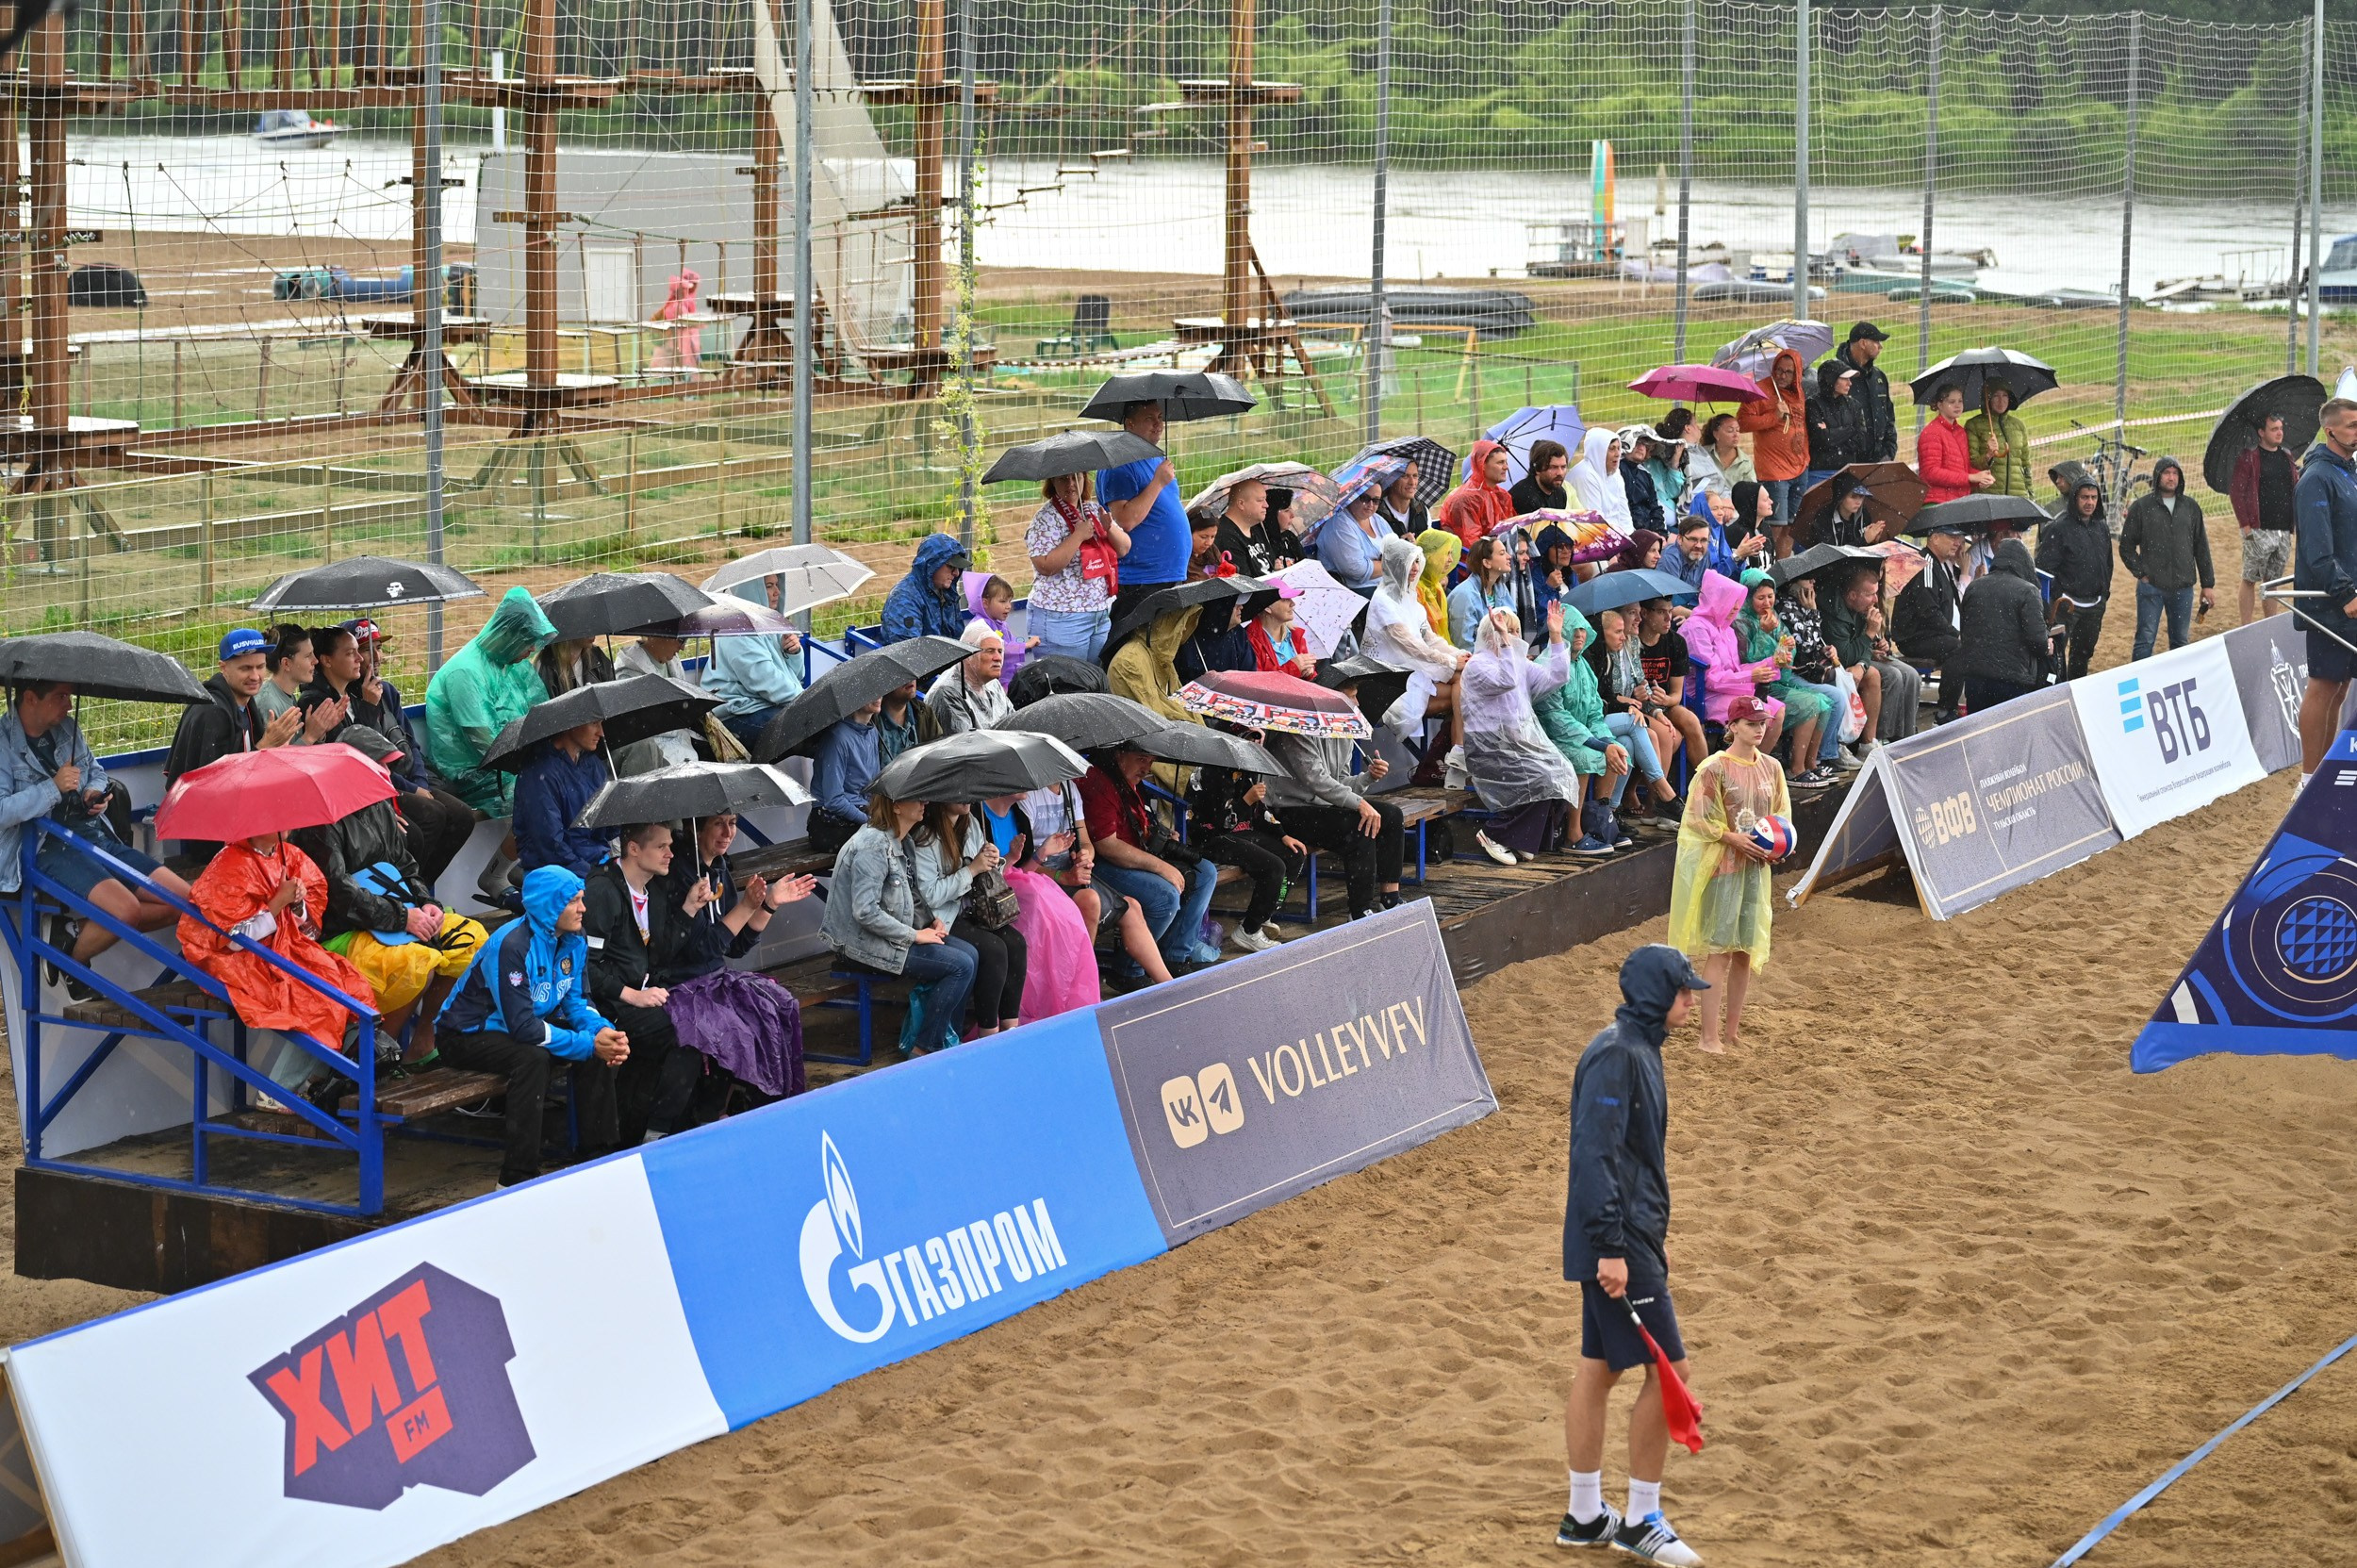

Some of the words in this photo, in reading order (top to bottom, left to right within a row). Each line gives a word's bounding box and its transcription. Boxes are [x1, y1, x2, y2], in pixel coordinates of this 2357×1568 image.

[232, 638, 265, 651] RUSVOLLE
[2146, 677, 2211, 765] ВТБ
[1979, 770, 2005, 789] ПЛЯЖНЫЙ
[2003, 763, 2028, 781] ВОЛЕЙБОЛ
[1985, 774, 2047, 813] ЧЕМПИОНАТ
[2045, 760, 2085, 790] РОССИИ
[1931, 791, 1977, 845] ВФВ
[2016, 806, 2036, 822] ОБЛАСТЬ
[1169, 1095, 1200, 1128] VK
[1246, 996, 1427, 1106] VOLLEYVFV
[882, 1197, 1067, 1327] ГАЗПРОМ
[265, 1278, 438, 1477] ХИТ
[404, 1409, 431, 1444] FM
